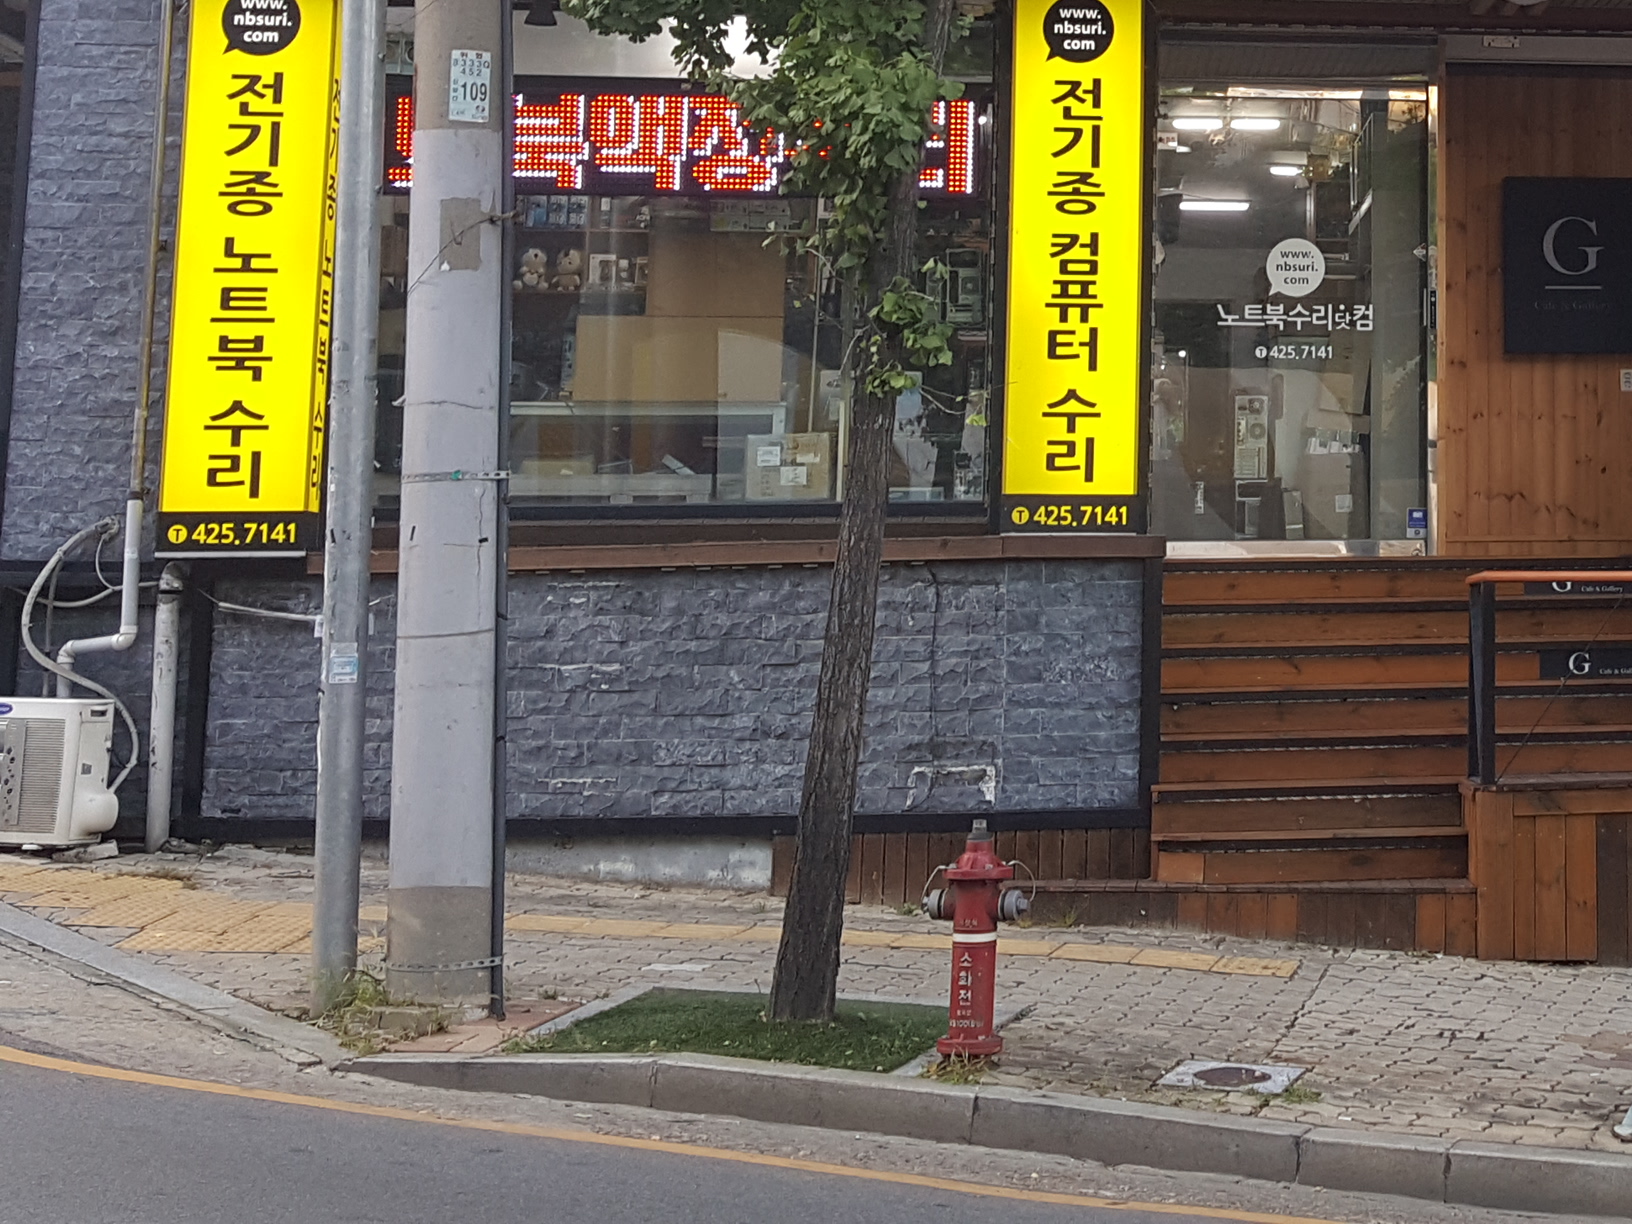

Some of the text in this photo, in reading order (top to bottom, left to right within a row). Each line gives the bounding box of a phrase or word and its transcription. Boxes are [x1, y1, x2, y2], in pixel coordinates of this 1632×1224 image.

[233, 11, 292, 27] nbsuri.
[1059, 7, 1101, 19] www.
[243, 29, 279, 43] com
[1053, 21, 1106, 36] nbsuri.
[1063, 38, 1096, 50] com
[461, 81, 487, 102] 109
[1543, 216, 1604, 275] G
[1280, 251, 1314, 259] www.
[1276, 261, 1318, 272] nbsuri.
[203, 72, 285, 499] 전기종 노트북 수리
[1041, 78, 1106, 484] 전기종 컴퓨터 수리
[1284, 276, 1309, 285] com
[1217, 303, 1373, 331] 노트북수리닷컴
[1269, 345, 1333, 359] 425.7141
[1033, 505, 1128, 527] 425.7141
[192, 522, 297, 546] 425.7141
[1568, 652, 1592, 675] G
[958, 952, 972, 1006] 소화전
